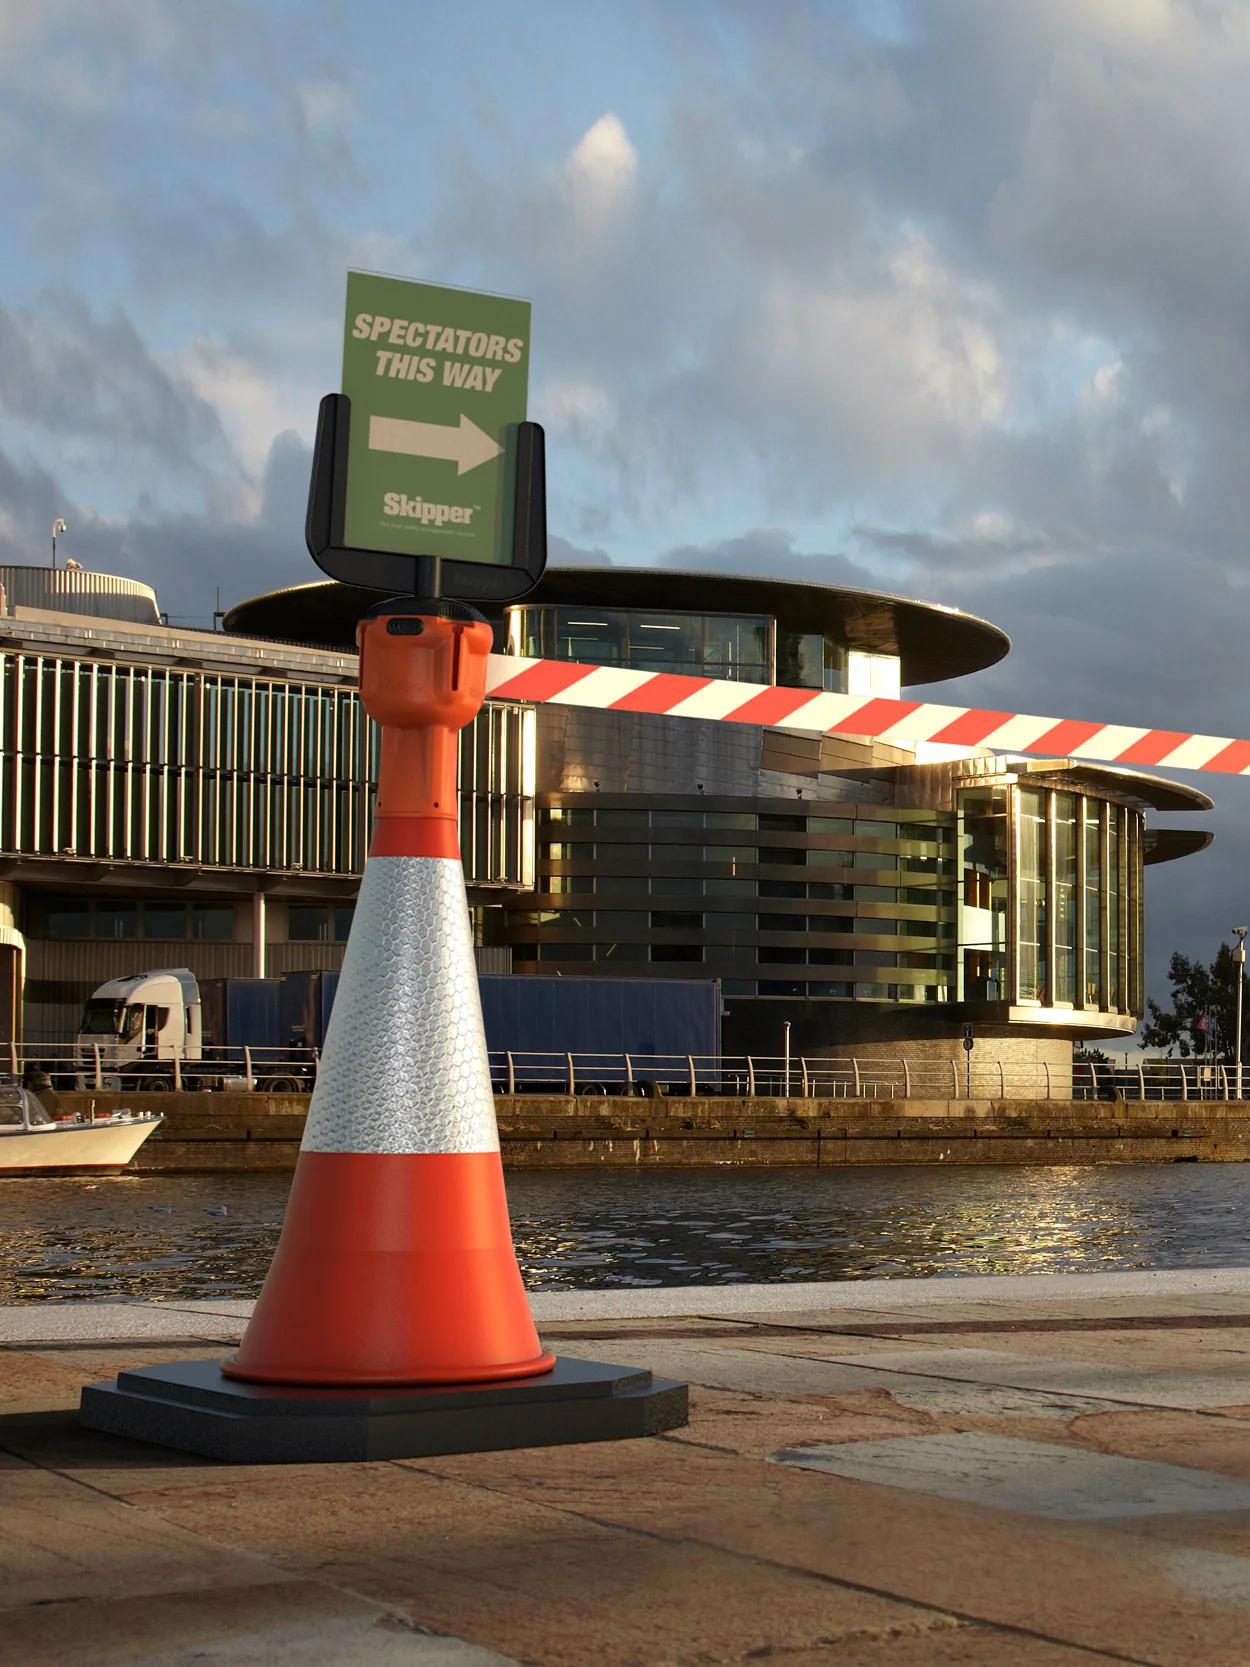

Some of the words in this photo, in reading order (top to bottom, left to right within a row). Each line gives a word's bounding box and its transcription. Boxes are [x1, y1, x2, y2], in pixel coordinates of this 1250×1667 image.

[352, 313, 524, 363] SPECTATORS
[375, 350, 436, 383] THIS
[442, 360, 503, 392] WAY
